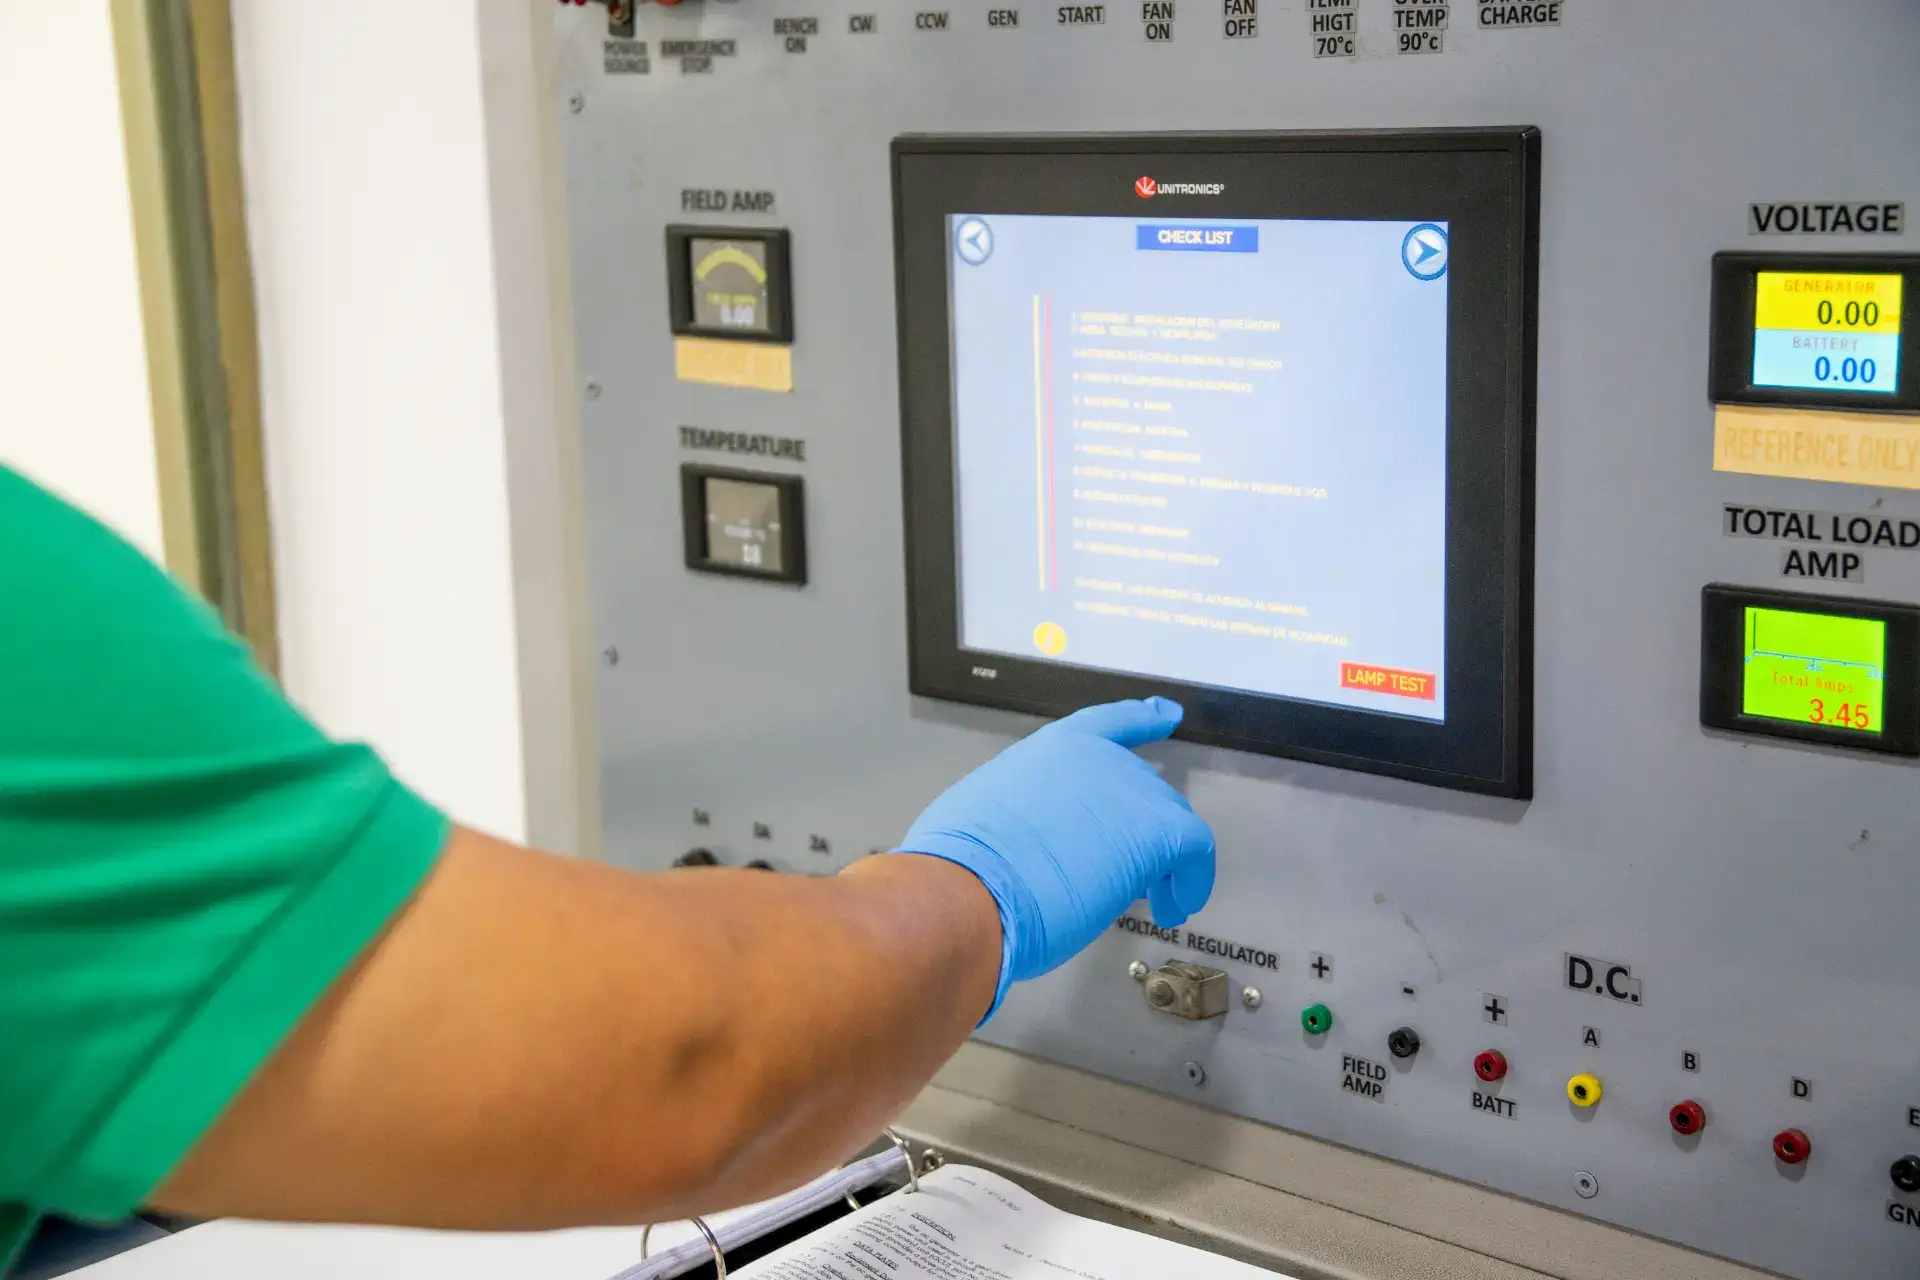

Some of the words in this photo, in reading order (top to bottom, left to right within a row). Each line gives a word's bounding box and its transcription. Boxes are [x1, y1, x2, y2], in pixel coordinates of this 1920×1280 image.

[988, 10, 1018, 26] GEN
[1058, 6, 1103, 24] START
[1143, 3, 1172, 20] FAN
[1224, 0, 1255, 16] FAN
[1480, 4, 1559, 26] CHARGE
[774, 18, 817, 35] BENCH
[850, 16, 873, 32] CW
[915, 12, 948, 29] CCW
[1225, 19, 1256, 37] OFF
[1313, 13, 1354, 32] HIGT
[1394, 9, 1446, 29] TEMP
[1146, 23, 1170, 40] ON
[786, 38, 805, 53] ON
[681, 189, 727, 211] FIELD
[731, 191, 775, 212] AMP
[1753, 204, 1899, 233] VOLTAGE
[1157, 229, 1202, 244] CHECK
[1205, 230, 1233, 245] LIST
[1784, 279, 1877, 293] GENERATOR
[1817, 300, 1879, 326] 0.00
[1792, 336, 1860, 352] BATTERY
[1814, 356, 1877, 383] 0.00
[680, 427, 806, 462] TEMPERATURE
[1724, 427, 1850, 467] REFERENCE
[1858, 434, 1920, 473] ONLY
[1726, 507, 1821, 540] TOTAL
[1832, 515, 1920, 548] LOAD
[1783, 551, 1860, 579] AMP
[1347, 667, 1387, 687] LAMP
[1389, 673, 1427, 693] TEST
[1771, 671, 1809, 687] Total
[1815, 676, 1855, 694] Amps
[1808, 697, 1869, 729] 3.45
[1117, 916, 1180, 944] VOLTAGE
[1187, 933, 1278, 970] REGULATOR
[1568, 956, 1639, 1003] D.C.
[1583, 1029, 1598, 1046] A
[1343, 1055, 1387, 1081] FIELD
[1684, 1053, 1696, 1070] B
[1343, 1074, 1382, 1098] AMP
[1794, 1080, 1808, 1097] D
[1473, 1092, 1516, 1117] BATT
